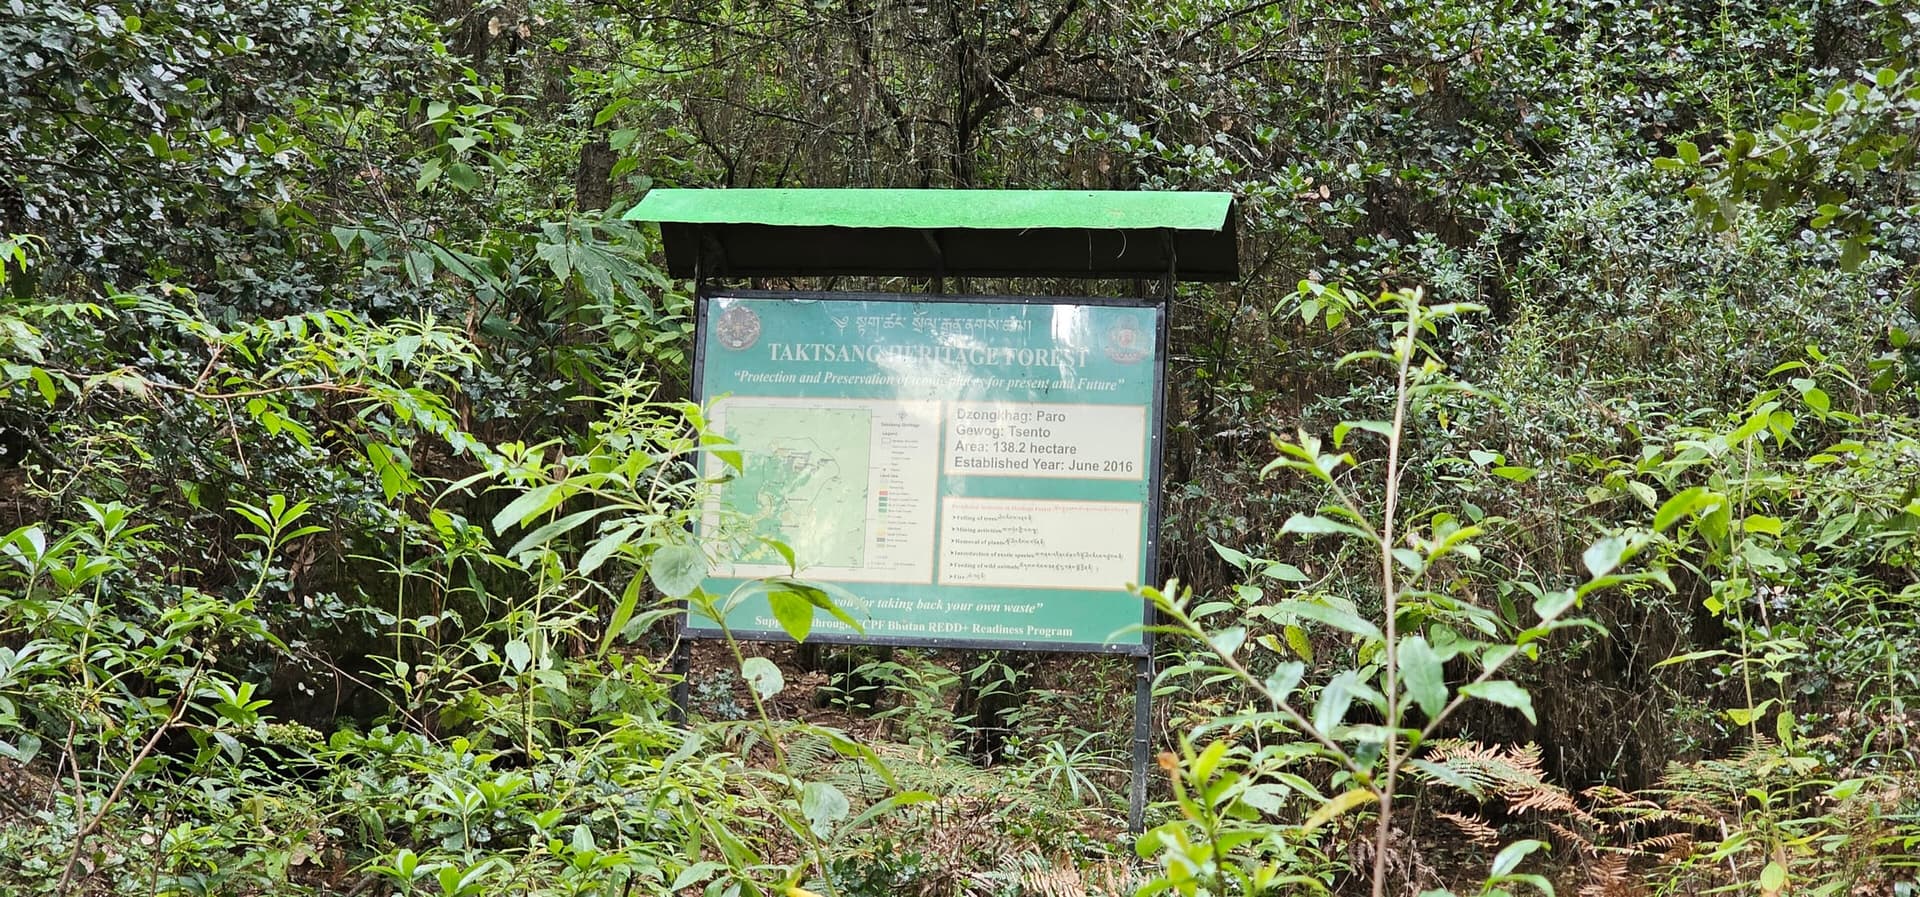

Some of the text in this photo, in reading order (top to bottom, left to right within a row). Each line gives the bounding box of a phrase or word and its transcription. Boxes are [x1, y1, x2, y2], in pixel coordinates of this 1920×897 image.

[768, 343, 1090, 368] TAKTSANG HERITAGE FOREST
[800, 371, 820, 384] and
[824, 372, 895, 386] Preservation
[986, 376, 1003, 389] for
[1006, 378, 1049, 391] present
[1052, 377, 1074, 390] and
[957, 408, 1066, 423] Dzongkhag: Paro
[956, 425, 1051, 439] Gewog: Tsento
[955, 440, 1077, 454] Area: 138.2 hectare
[954, 456, 1133, 472] Established Year: June 2016
[854, 597, 874, 610] for
[877, 598, 913, 611] taking
[917, 599, 943, 610] back
[945, 601, 973, 613] your
[976, 604, 1000, 612] own
[888, 619, 925, 631] Bhutan
[928, 621, 969, 633] REDD+
[972, 623, 1024, 635] Readiness
[1027, 625, 1073, 638] Program
